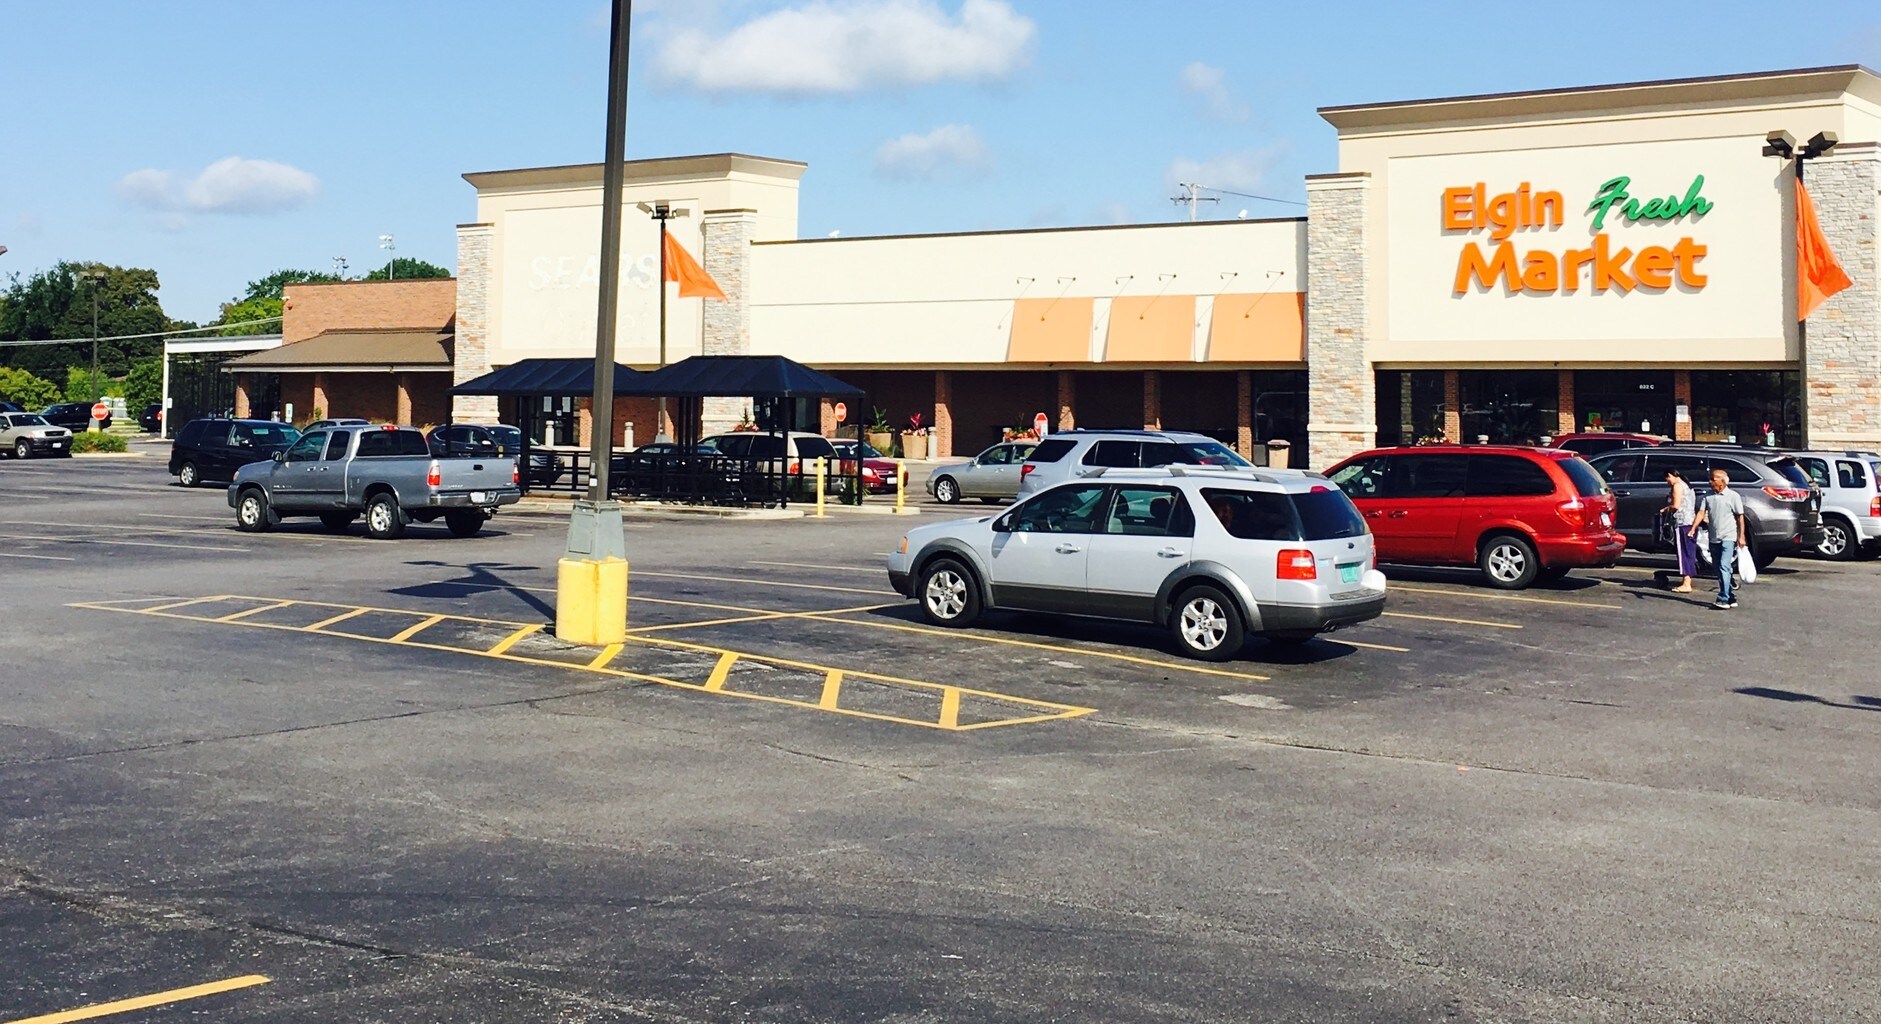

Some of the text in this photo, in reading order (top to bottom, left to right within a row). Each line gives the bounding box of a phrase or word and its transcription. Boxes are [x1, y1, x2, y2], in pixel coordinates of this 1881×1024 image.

[1443, 174, 1713, 241] Elgin Fresh
[1454, 233, 1708, 294] Market
